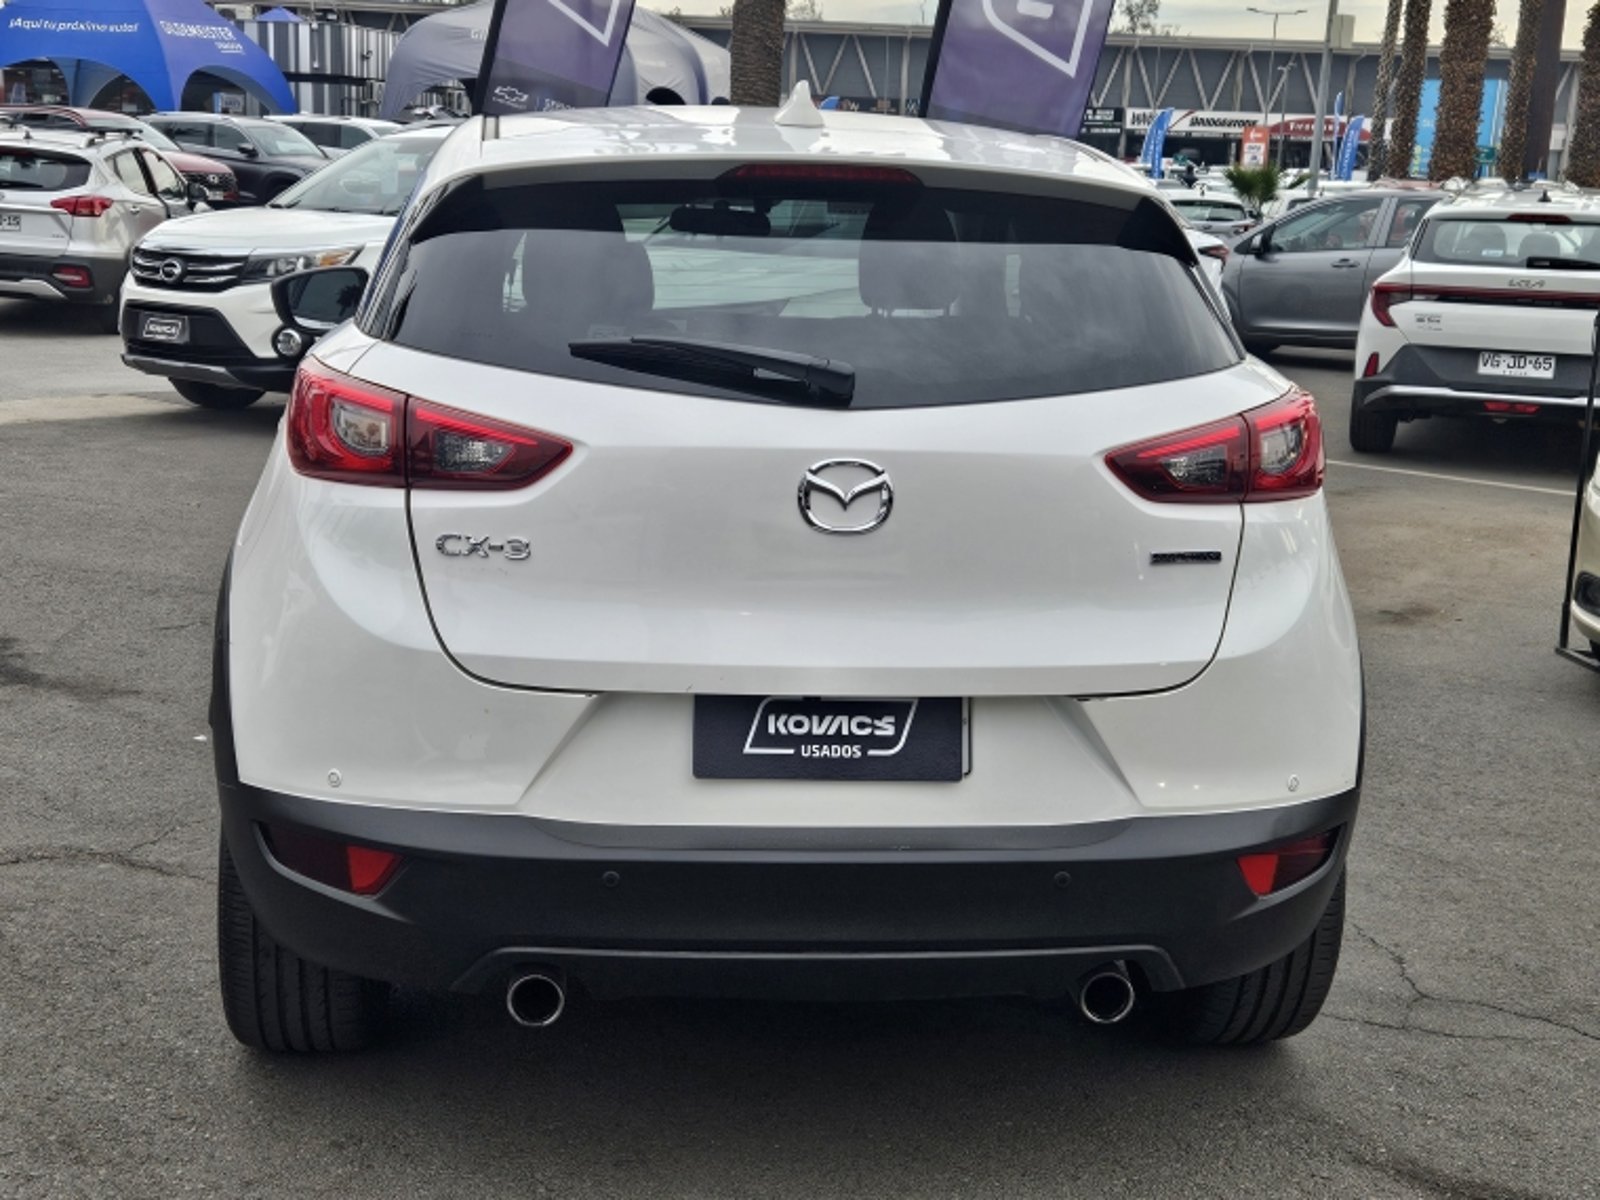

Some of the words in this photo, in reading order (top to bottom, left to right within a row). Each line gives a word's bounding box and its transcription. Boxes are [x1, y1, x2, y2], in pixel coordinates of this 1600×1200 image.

[436, 532, 532, 561] CX-3
[767, 713, 896, 736] KOVACS
[800, 744, 862, 759] USADOS
